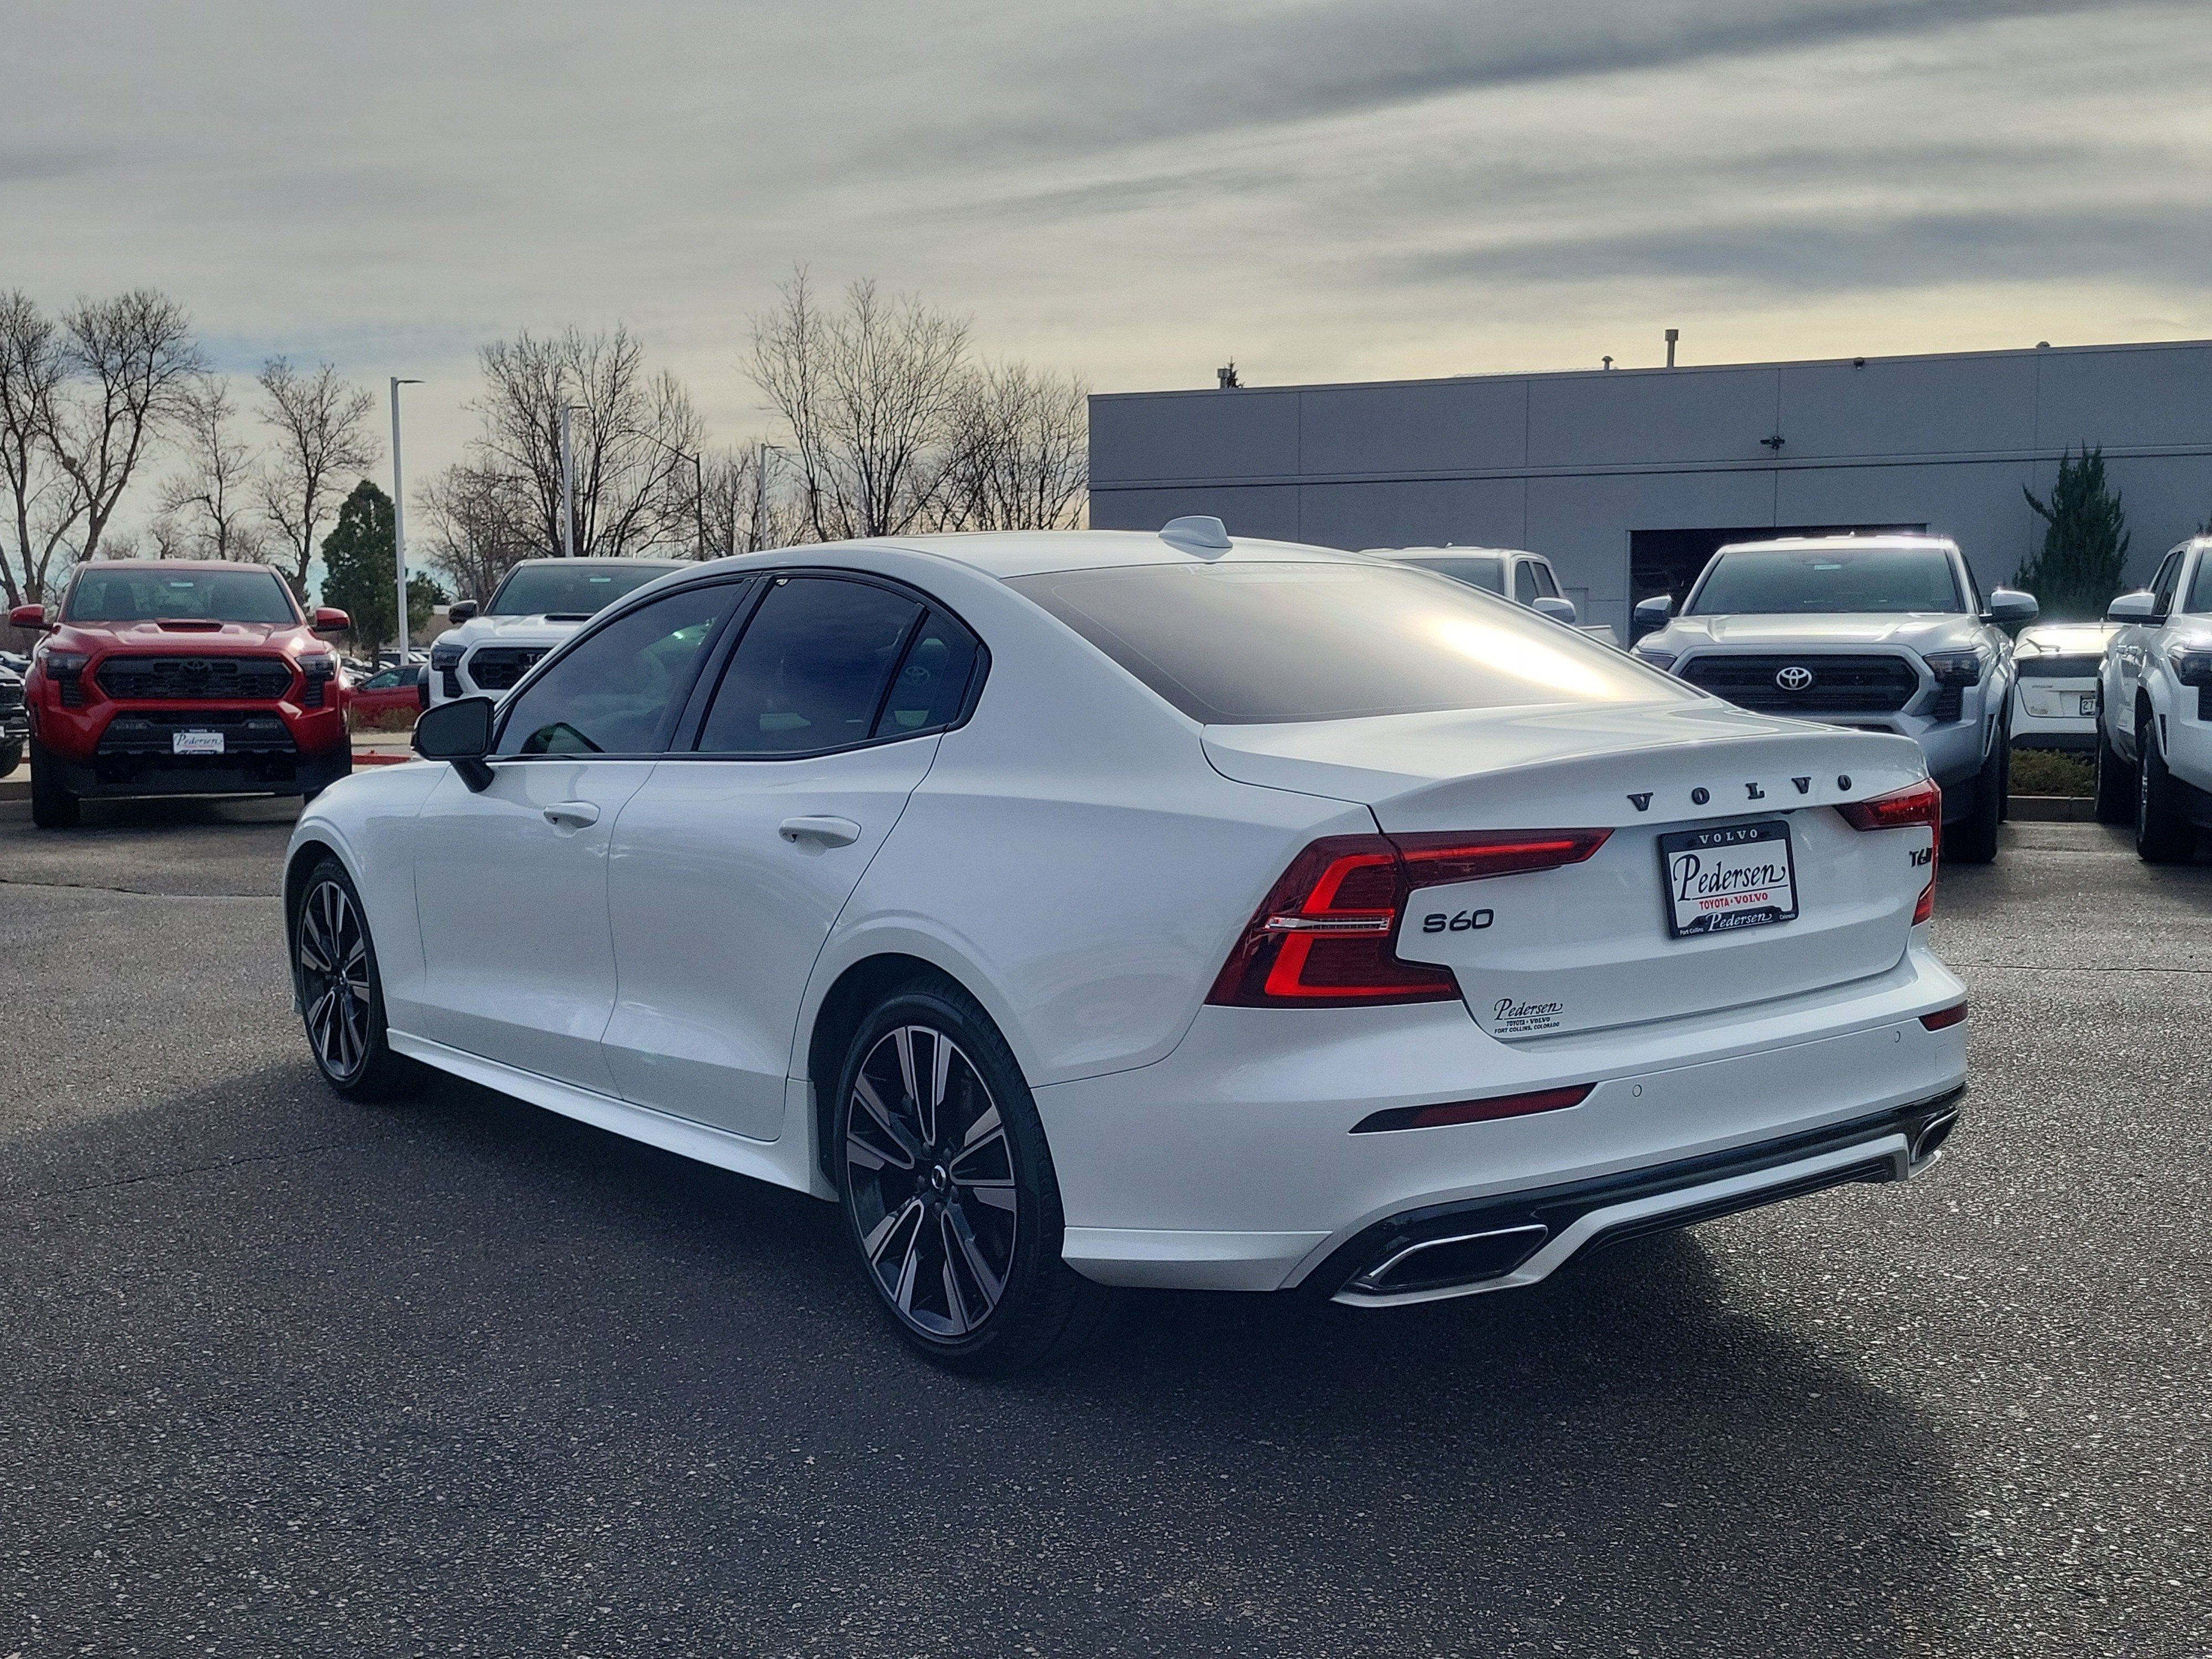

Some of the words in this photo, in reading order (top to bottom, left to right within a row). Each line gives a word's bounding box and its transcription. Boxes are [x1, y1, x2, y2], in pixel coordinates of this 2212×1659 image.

[1627, 774, 1852, 811] VOLVO
[1699, 829, 1757, 844] VOLVO
[1673, 853, 1786, 902] Pedersen
[1699, 898, 1729, 910] TOYOTA
[1734, 893, 1768, 904] VOLVO
[1423, 909, 1494, 933] S60
[1705, 912, 1772, 932] Pedersen
[1494, 998, 1563, 1020] Pedersen
